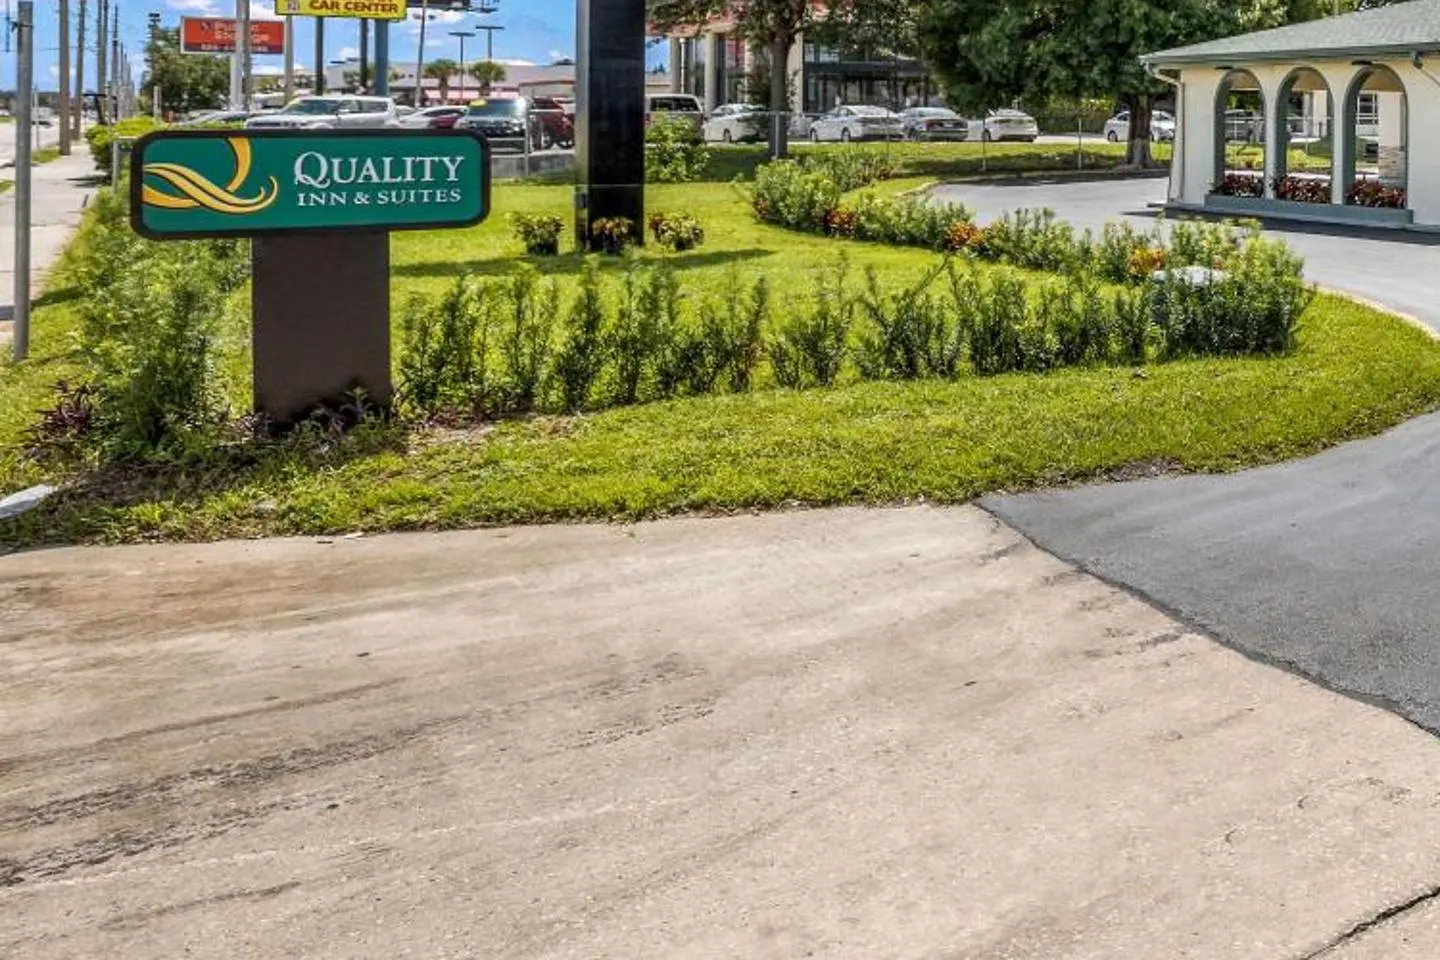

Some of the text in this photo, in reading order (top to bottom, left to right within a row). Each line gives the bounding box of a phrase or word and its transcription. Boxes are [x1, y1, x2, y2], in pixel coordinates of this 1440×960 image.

[309, 0, 399, 14] CAR CENTER
[294, 151, 464, 189] QUALITY
[297, 188, 462, 207] INN & SUITES
